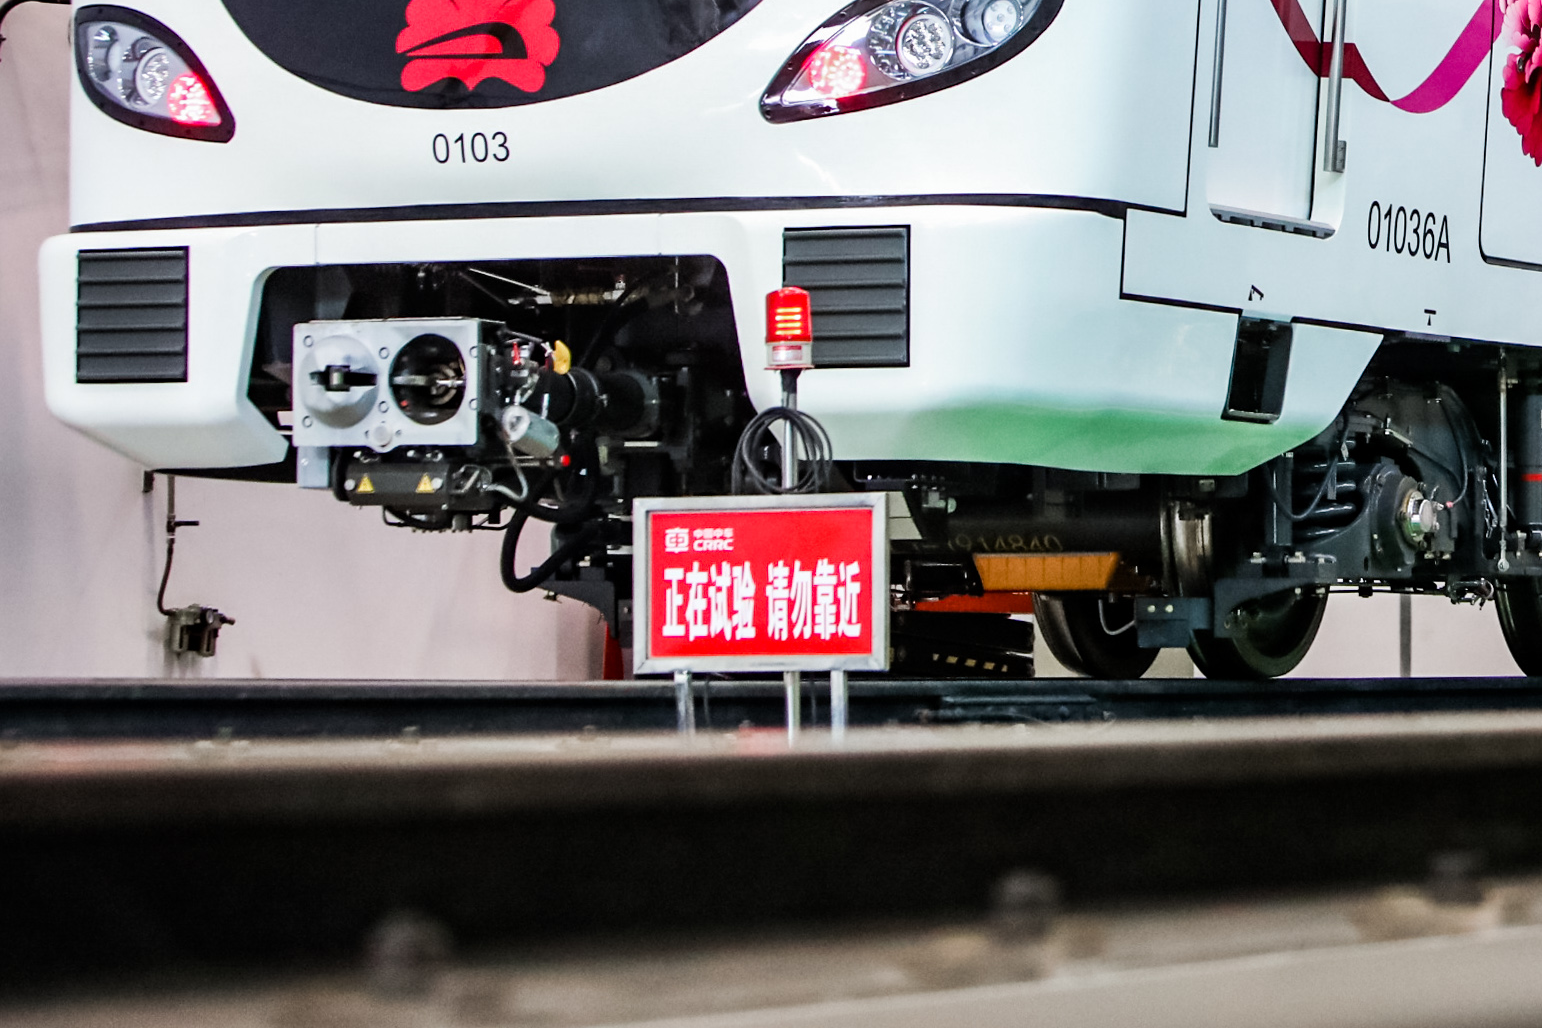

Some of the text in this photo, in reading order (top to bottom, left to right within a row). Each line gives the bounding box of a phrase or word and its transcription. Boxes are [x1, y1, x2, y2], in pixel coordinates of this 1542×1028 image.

[432, 131, 510, 164] 0103
[1367, 200, 1451, 264] 01036A
[693, 539, 734, 551] CRRC
[662, 559, 862, 641] 正在试验 请勿靠近
